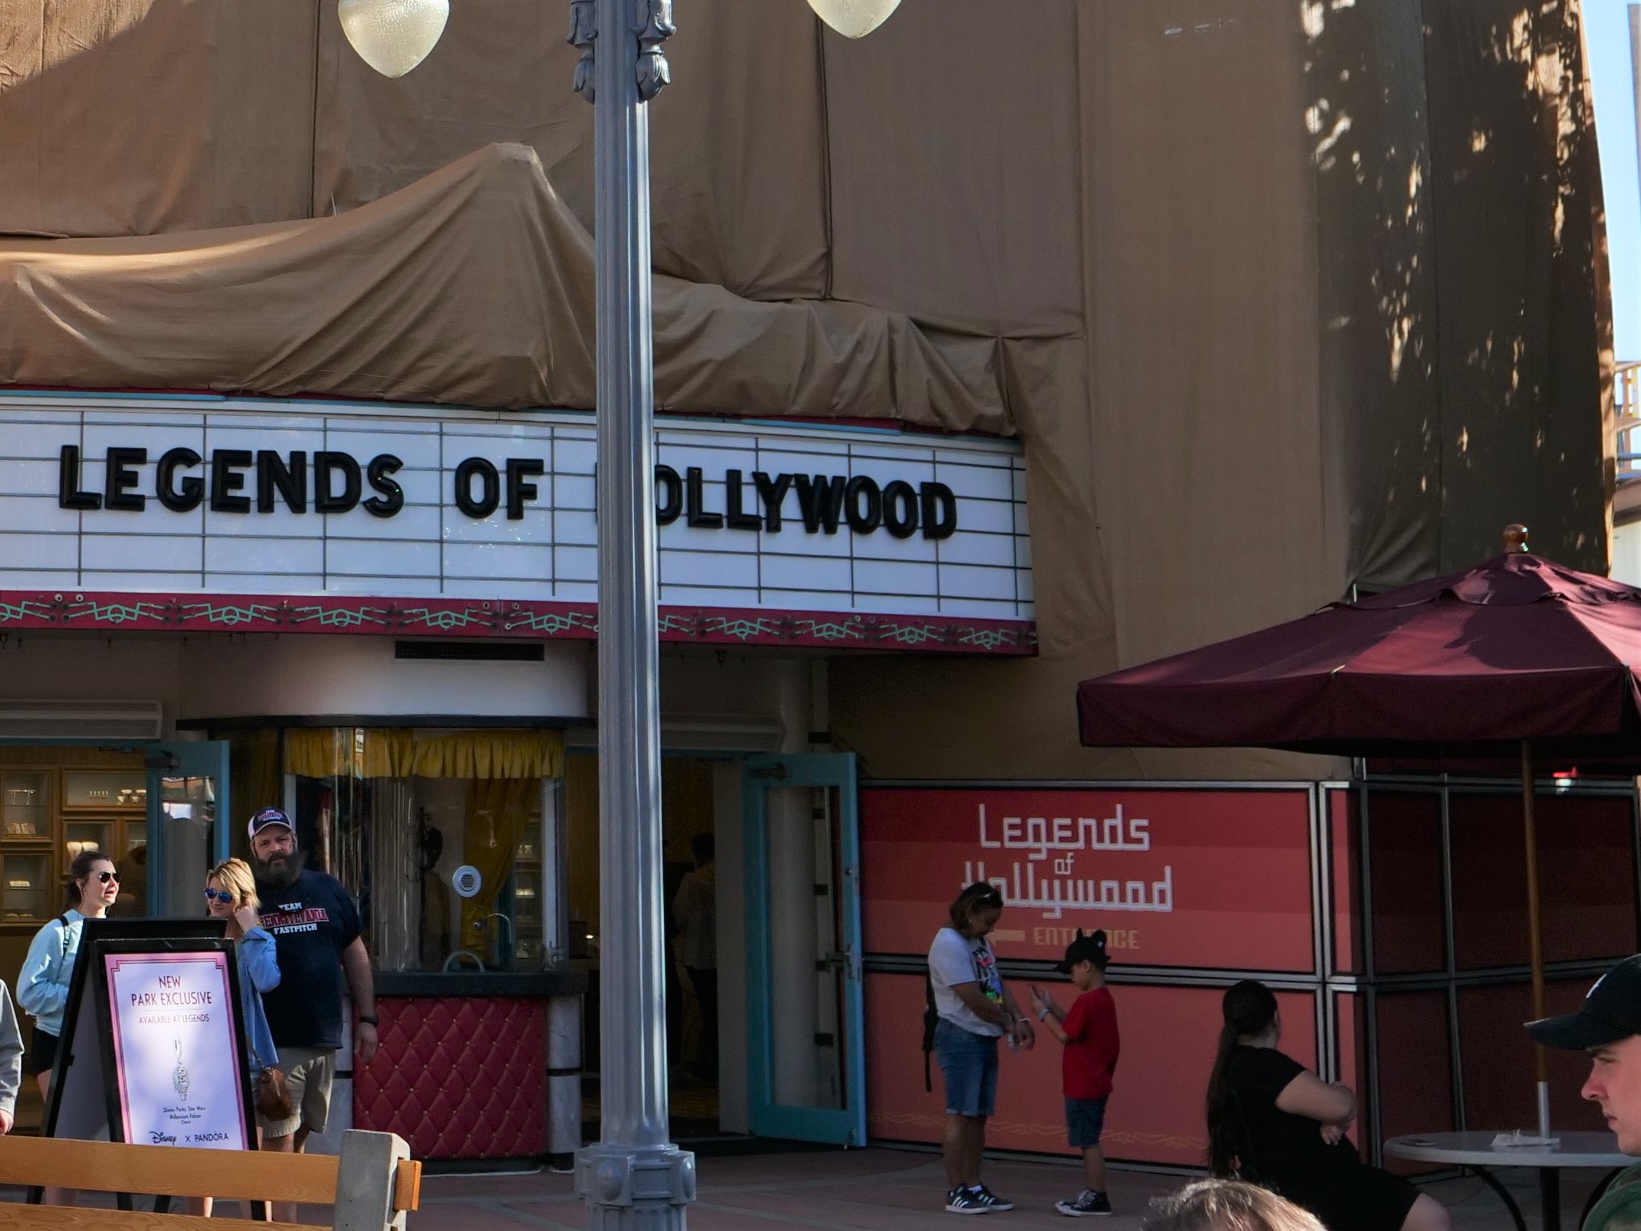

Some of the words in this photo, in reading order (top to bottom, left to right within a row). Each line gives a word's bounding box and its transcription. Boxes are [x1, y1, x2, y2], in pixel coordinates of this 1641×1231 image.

[59, 443, 404, 519] LEGENDS
[454, 455, 545, 520] OF
[595, 462, 958, 541] OLLYWOOD
[979, 803, 1150, 860] Legends
[1054, 852, 1074, 875] of
[278, 902, 302, 911] TEAM
[273, 923, 318, 935] FASTPITCH
[1033, 927, 1140, 949] ENTNCE
[159, 975, 181, 988] NEW
[131, 993, 157, 1006] PARK
[160, 991, 212, 1005] EXCLUSIVE
[139, 1015, 171, 1024] AVAILABLE
[173, 1015, 181, 1023] AT
[183, 1014, 210, 1023] LEGENDS
[195, 1132, 230, 1143] PANDORA
